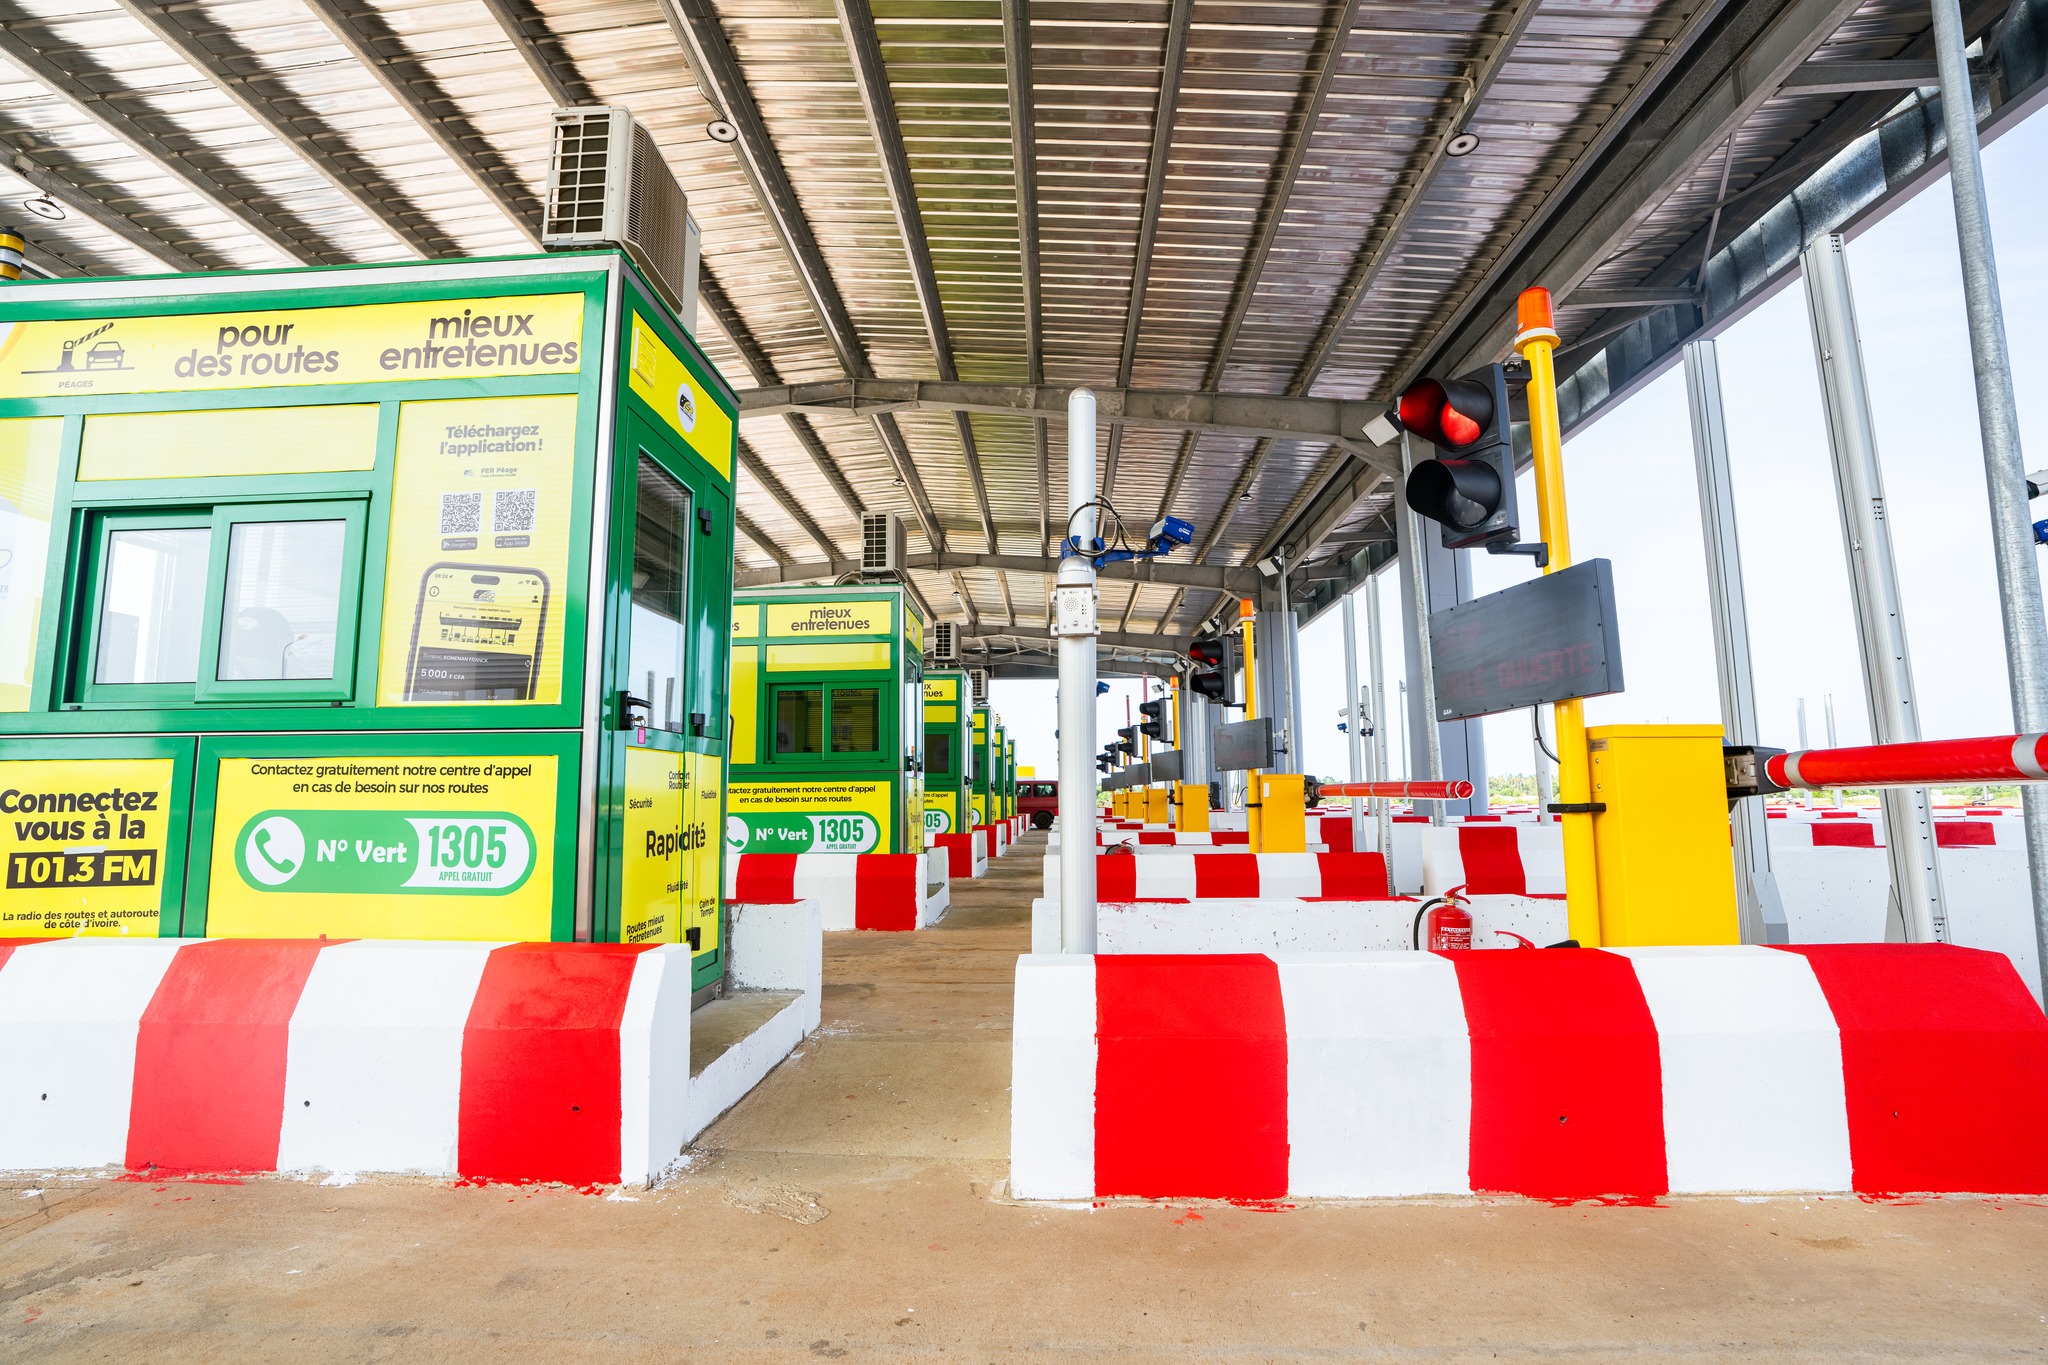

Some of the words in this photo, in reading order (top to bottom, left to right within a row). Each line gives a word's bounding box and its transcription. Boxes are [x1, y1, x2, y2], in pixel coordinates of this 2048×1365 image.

[429, 308, 534, 339] mieux
[217, 323, 294, 354] pour
[174, 349, 232, 378] des
[240, 345, 340, 376] routes
[380, 338, 578, 370] entretenues
[58, 380, 94, 388] PÉAGES
[446, 424, 539, 441] Téléchargez
[810, 607, 851, 619] mieux
[791, 618, 870, 631] entretenues
[251, 764, 313, 775] Contactez
[316, 764, 399, 778] gratuitement
[402, 764, 436, 776] notre
[440, 764, 480, 776] centre
[484, 764, 532, 778] d'appel
[293, 783, 308, 792] en
[312, 783, 332, 792] cas
[335, 781, 351, 792] de
[355, 781, 396, 793] besoin
[399, 784, 419, 793] sur
[422, 784, 445, 793] nos
[448, 782, 488, 793] routes
[752, 786, 800, 795] gratuitement
[0, 788, 158, 814] Connectez
[629, 798, 652, 809] Sécurité
[15, 819, 85, 841] vous
[93, 813, 110, 839] à
[120, 814, 145, 839] la
[924, 813, 941, 828] 05
[778, 828, 808, 841] Vert
[819, 819, 864, 842] 1305
[428, 825, 507, 868] 1305
[646, 822, 706, 862] Rapidité
[355, 840, 407, 863] Vert
[15, 856, 94, 883] 101.3
[103, 856, 151, 881] FM
[439, 871, 460, 881] APPEL
[461, 872, 492, 882] GRATUIT
[699, 900, 709, 909] Gain
[710, 896, 715, 905] de
[17, 912, 41, 920] radio
[45, 911, 61, 919] des
[65, 911, 95, 920] routes
[98, 910, 107, 919] et
[110, 909, 160, 918] autoroute
[700, 907, 714, 917] Temps
[60, 920, 80, 928] côte
[627, 921, 646, 935] Routes
[648, 914, 664, 927] mieux
[629, 925, 662, 943] Entretenues
